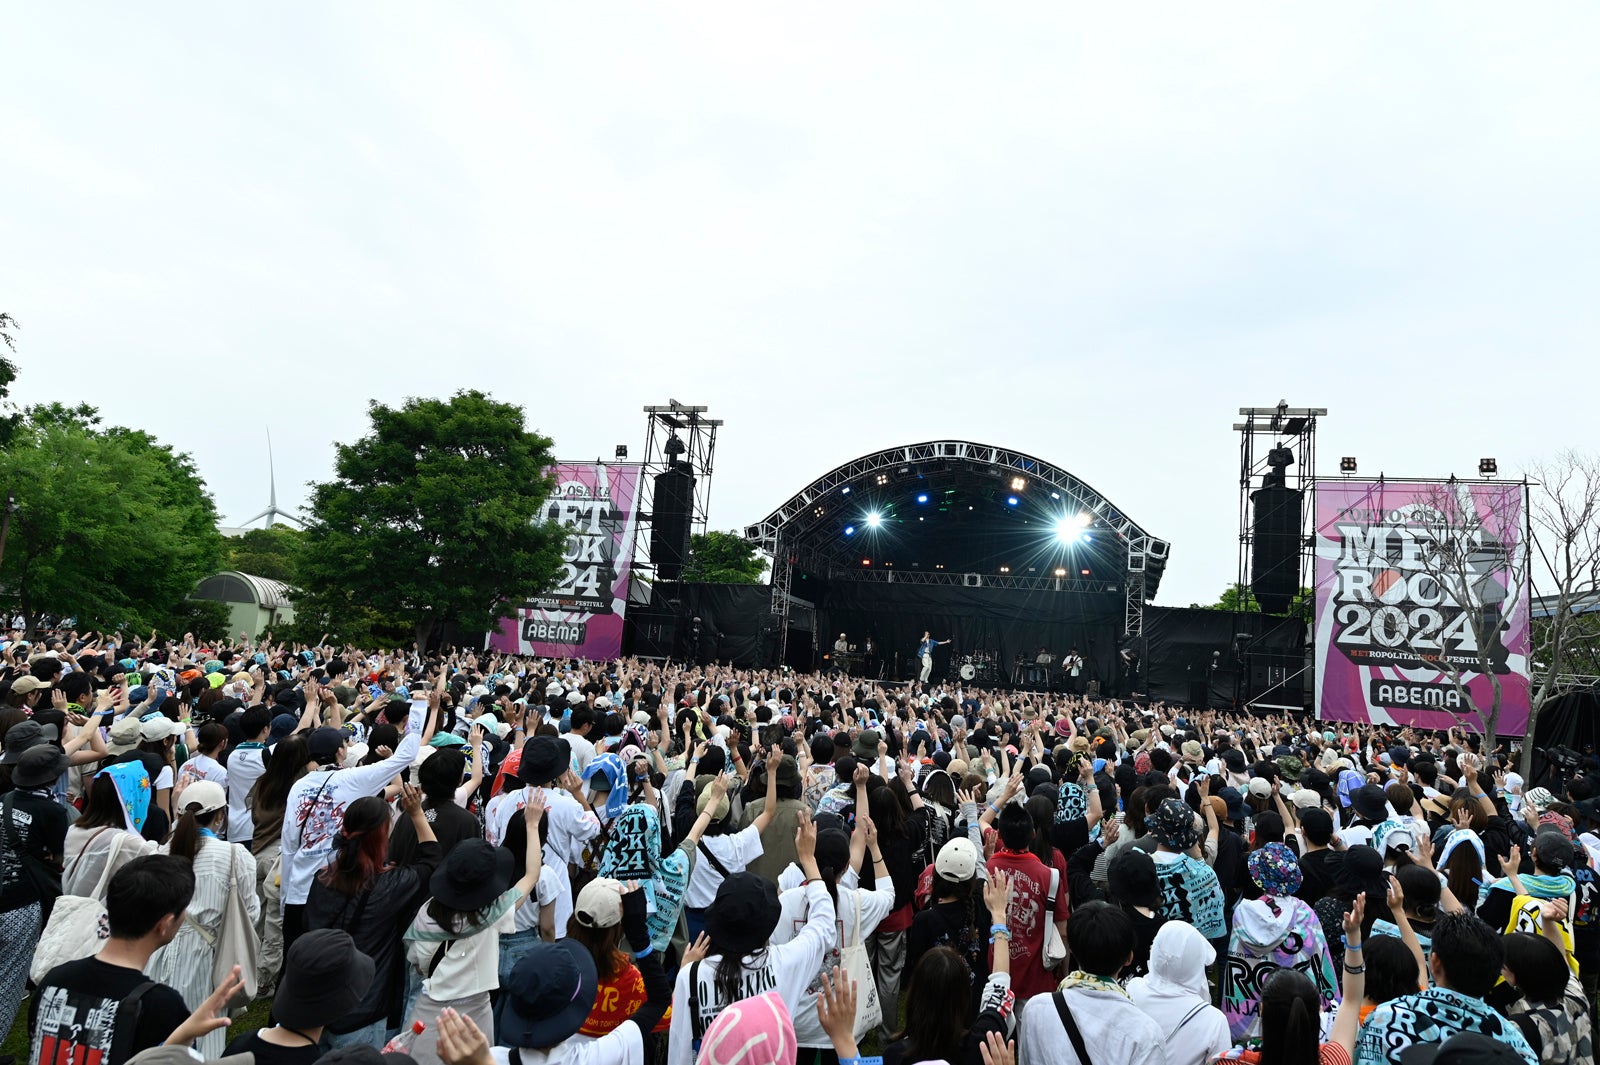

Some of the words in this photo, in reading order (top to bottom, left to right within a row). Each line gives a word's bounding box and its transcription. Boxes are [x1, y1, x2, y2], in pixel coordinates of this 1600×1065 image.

[1337, 526, 1482, 572] MET
[552, 563, 601, 597] 24
[527, 623, 580, 641] ABEMA
[1336, 603, 1478, 651] 2024
[1378, 684, 1461, 708] ABEMA
